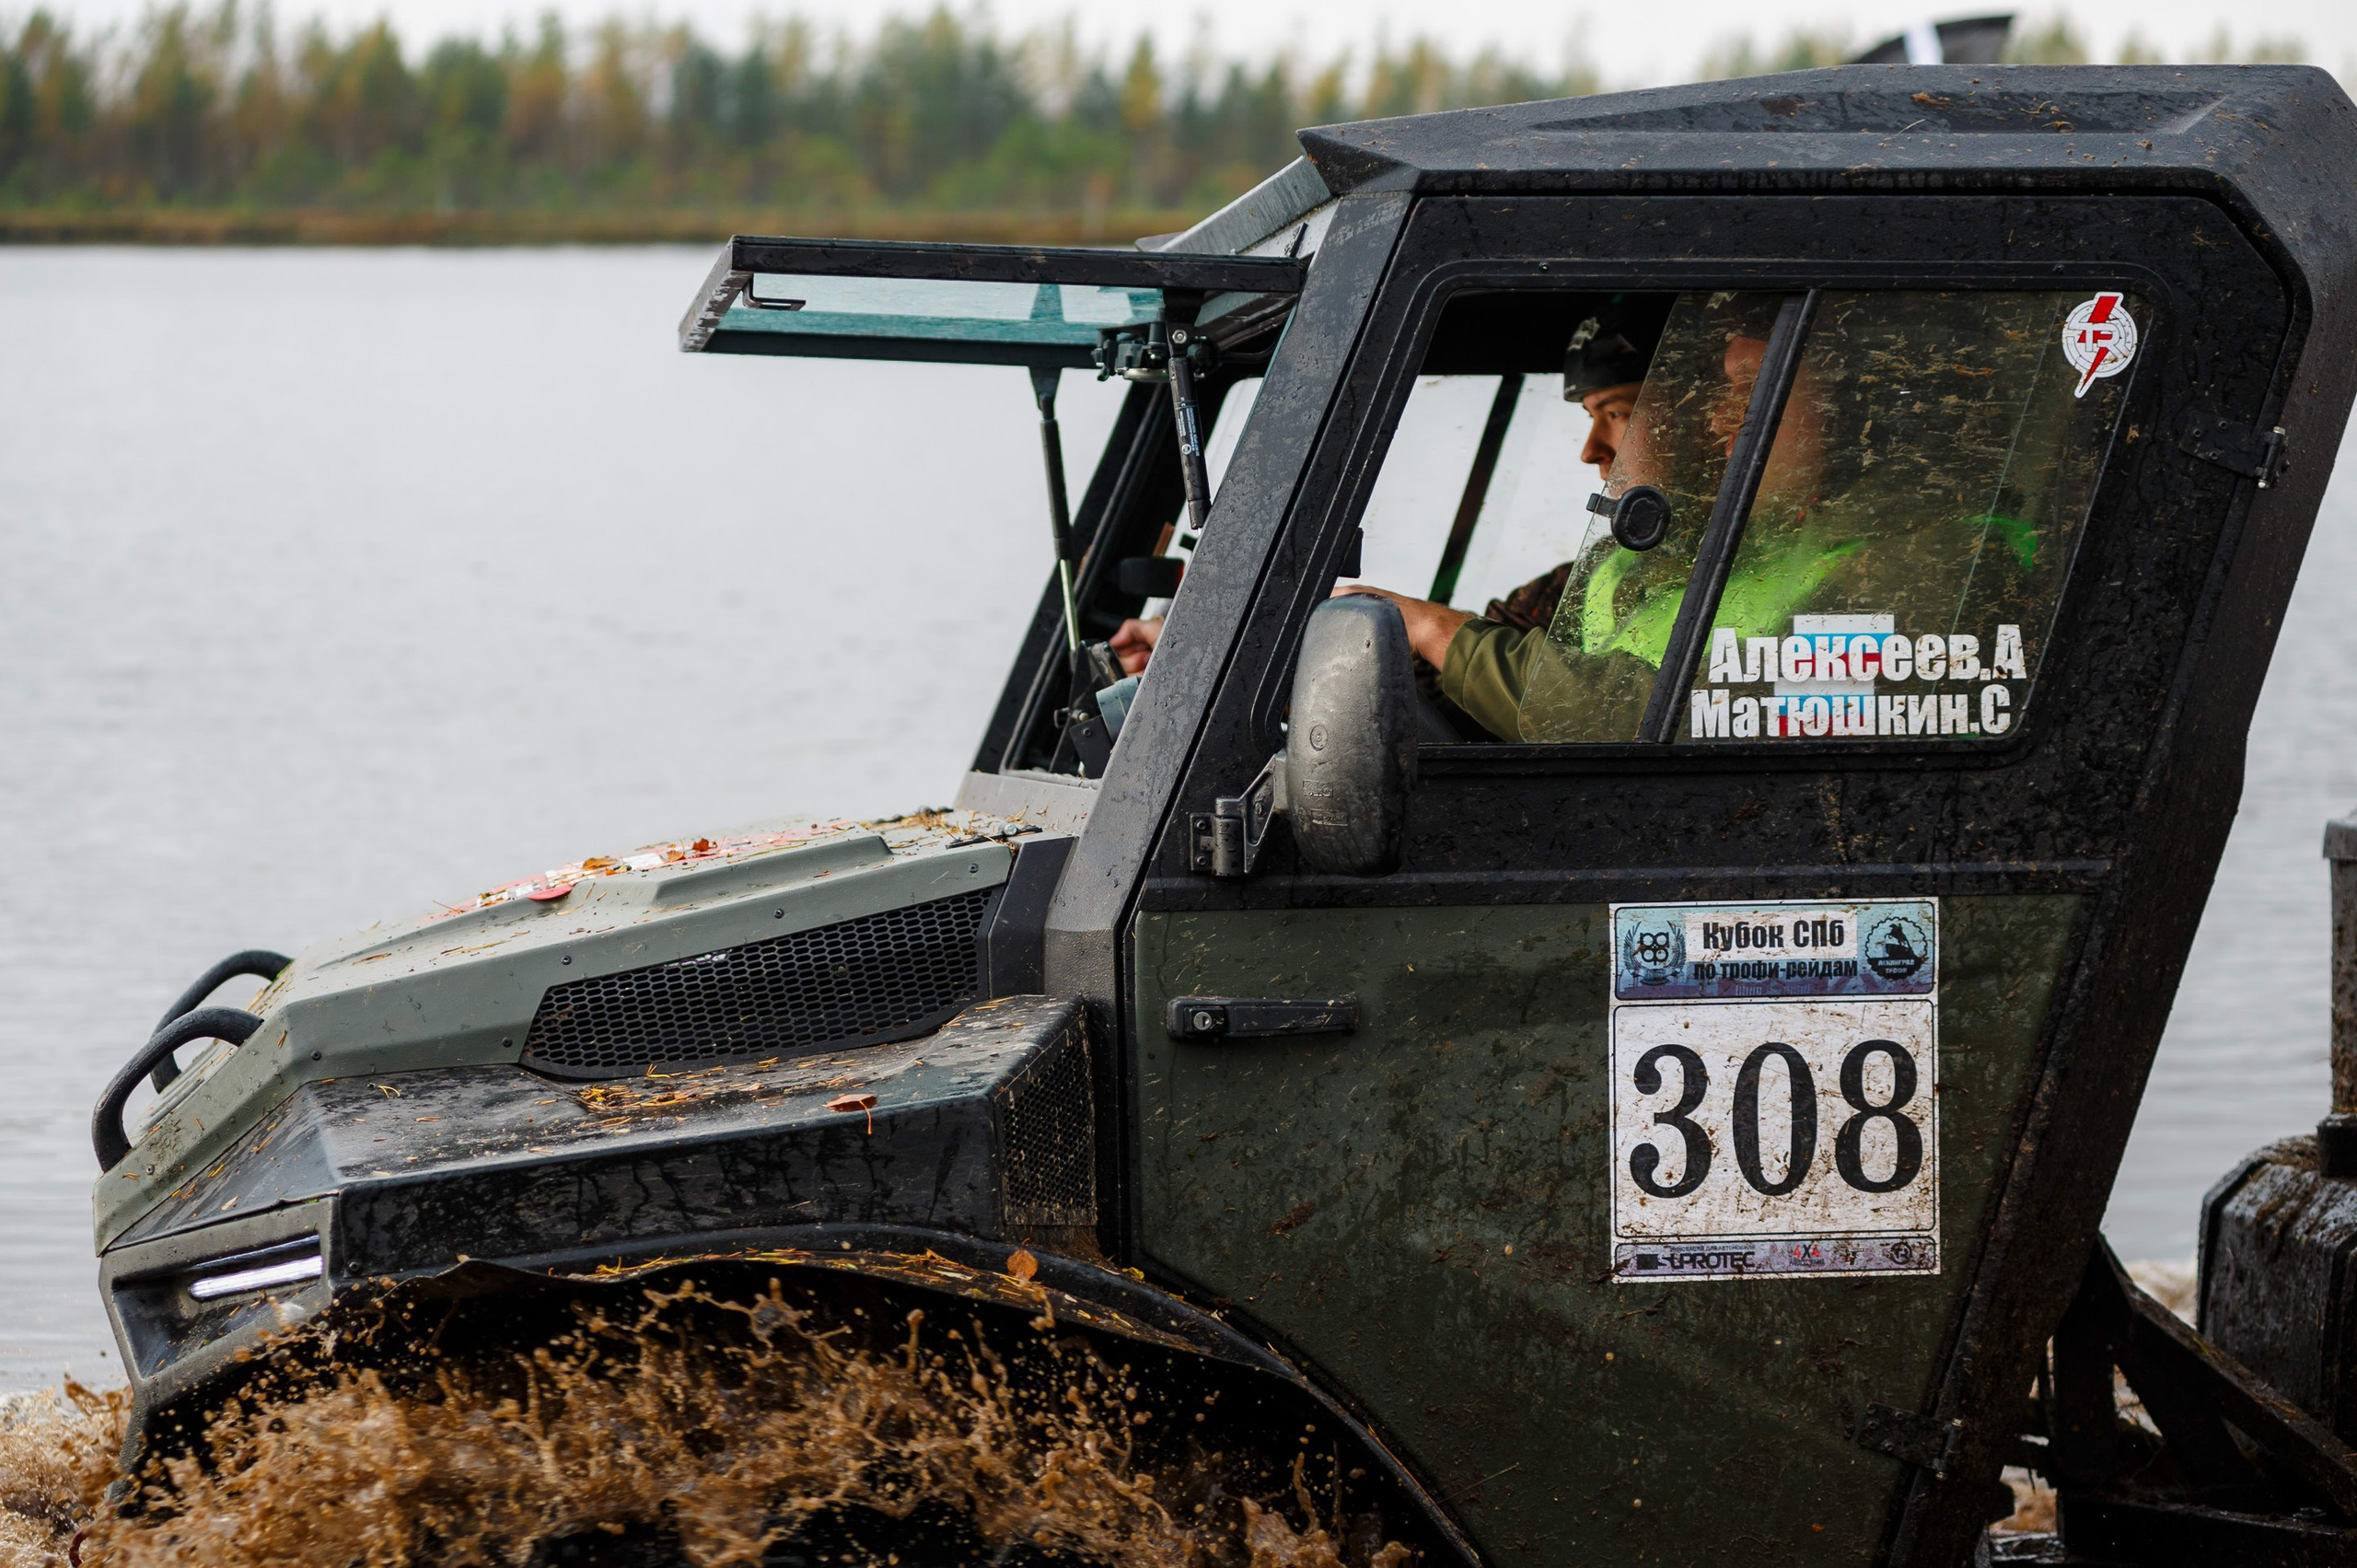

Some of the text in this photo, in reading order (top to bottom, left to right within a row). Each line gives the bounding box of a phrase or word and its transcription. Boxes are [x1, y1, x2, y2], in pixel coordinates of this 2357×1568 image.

[1709, 624, 2027, 683] Алексеев.А
[1691, 684, 2011, 738] Матюшкин.С
[1703, 919, 1845, 952] Кубок СПб
[1694, 958, 1858, 981] по трофи-рейдам
[1630, 1040, 1922, 1198] 308
